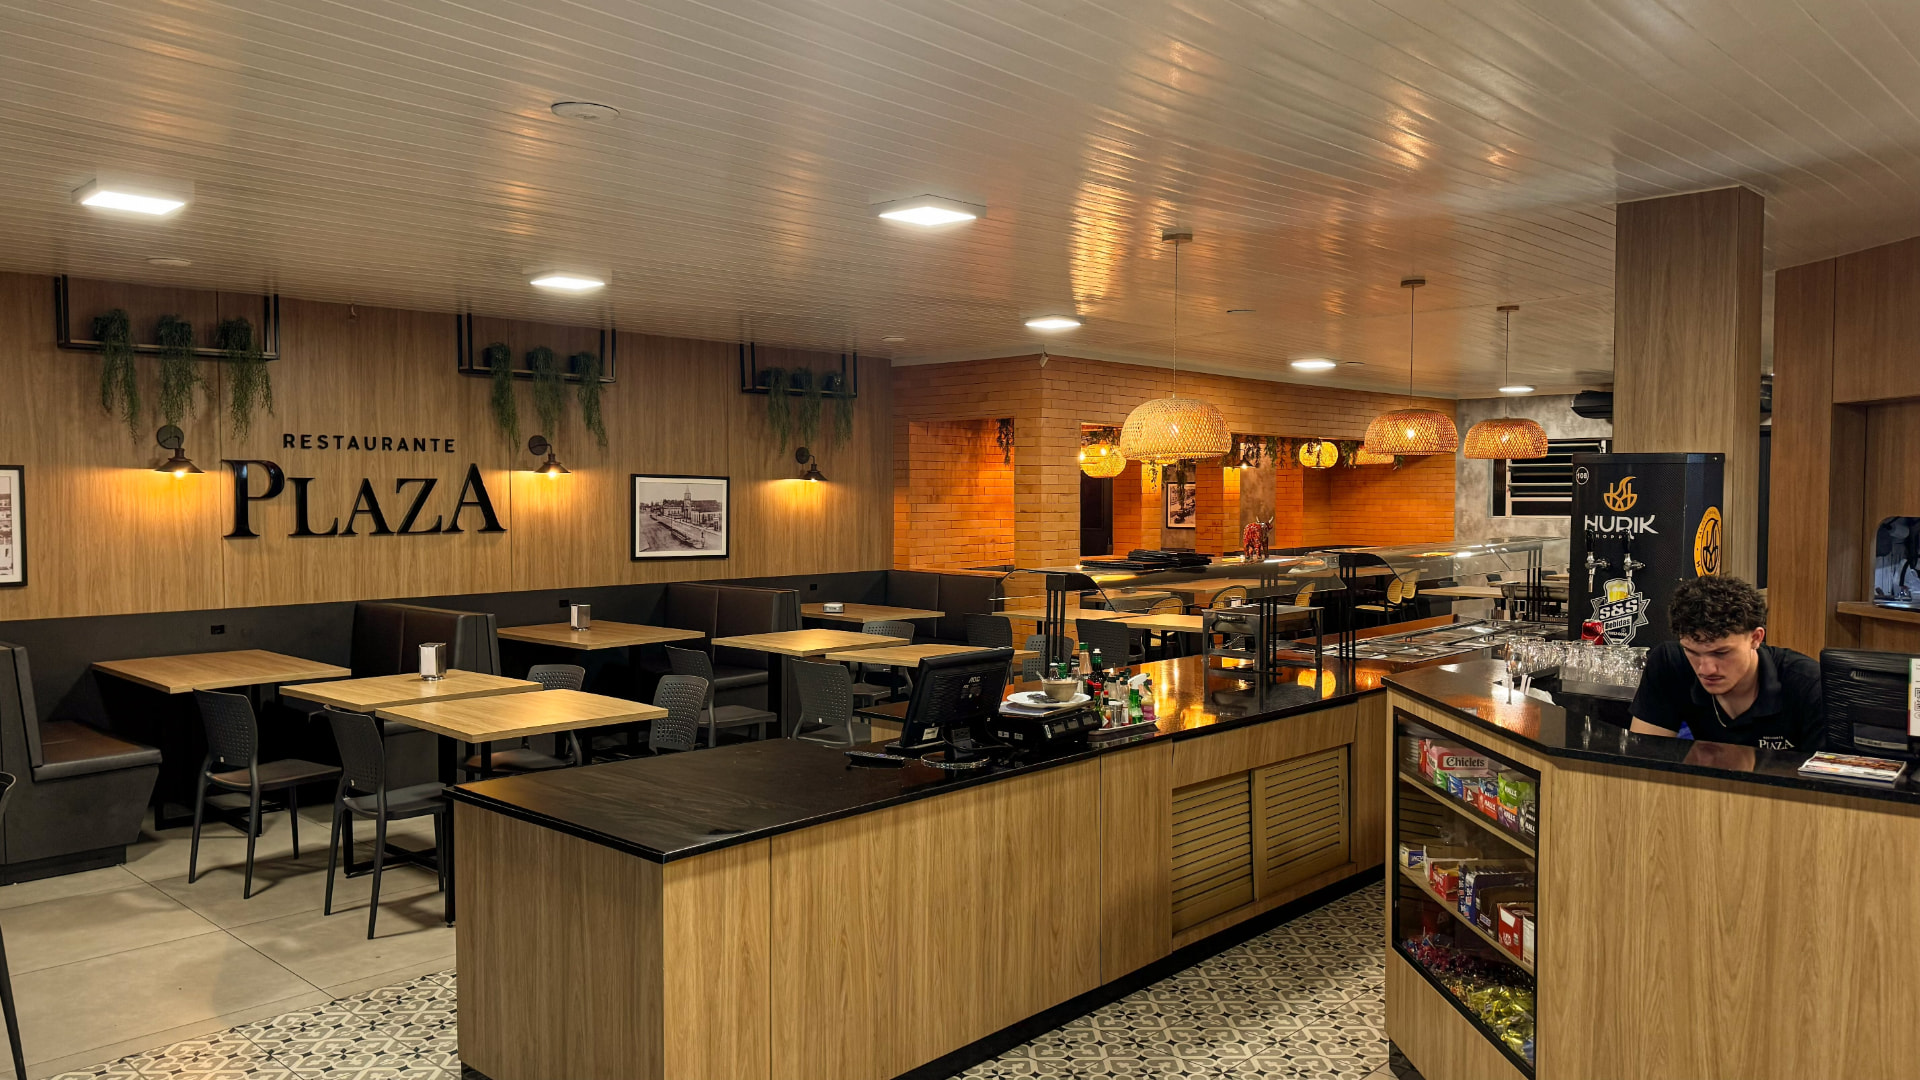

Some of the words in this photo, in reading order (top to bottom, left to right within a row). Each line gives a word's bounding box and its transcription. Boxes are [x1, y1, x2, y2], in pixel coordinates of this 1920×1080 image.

[282, 433, 456, 453] RESTAURANTE
[220, 458, 508, 538] PLAZA
[1599, 599, 1638, 620] S&S
[1446, 756, 1485, 767] Chiclets
